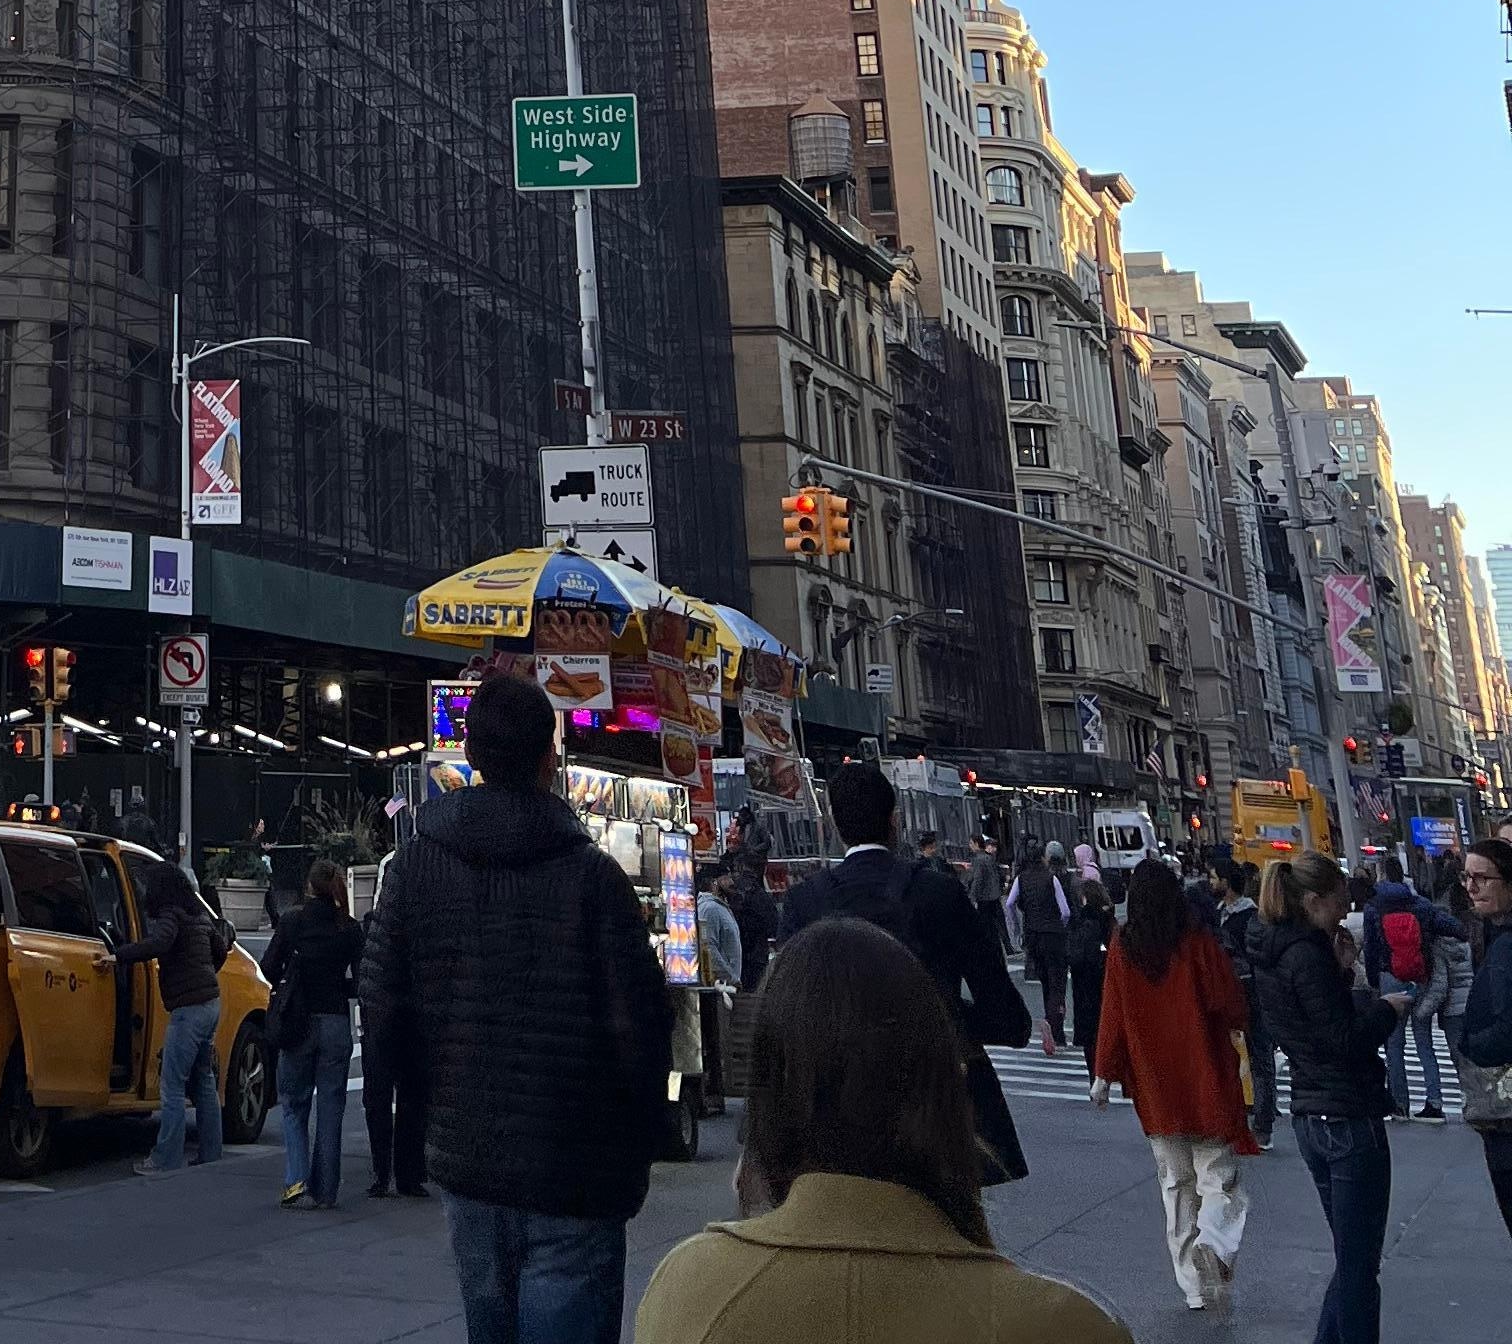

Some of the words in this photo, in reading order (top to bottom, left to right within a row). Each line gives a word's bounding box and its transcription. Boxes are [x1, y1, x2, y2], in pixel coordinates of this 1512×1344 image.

[523, 107, 574, 126] West
[582, 104, 627, 124] Side
[530, 129, 621, 153] Highway
[192, 380, 235, 428] FLATIRON
[618, 419, 632, 437] W
[640, 419, 657, 438] 23
[665, 419, 682, 439] St
[199, 459, 234, 494] NOMAD
[599, 464, 643, 480] TRUCK
[601, 492, 645, 507] ROUTE
[71, 557, 93, 568] AECOM
[459, 566, 538, 581] SABRETT
[555, 599, 587, 609] Pretzel
[424, 602, 527, 627] SABRETT
[562, 656, 601, 665] Churros
